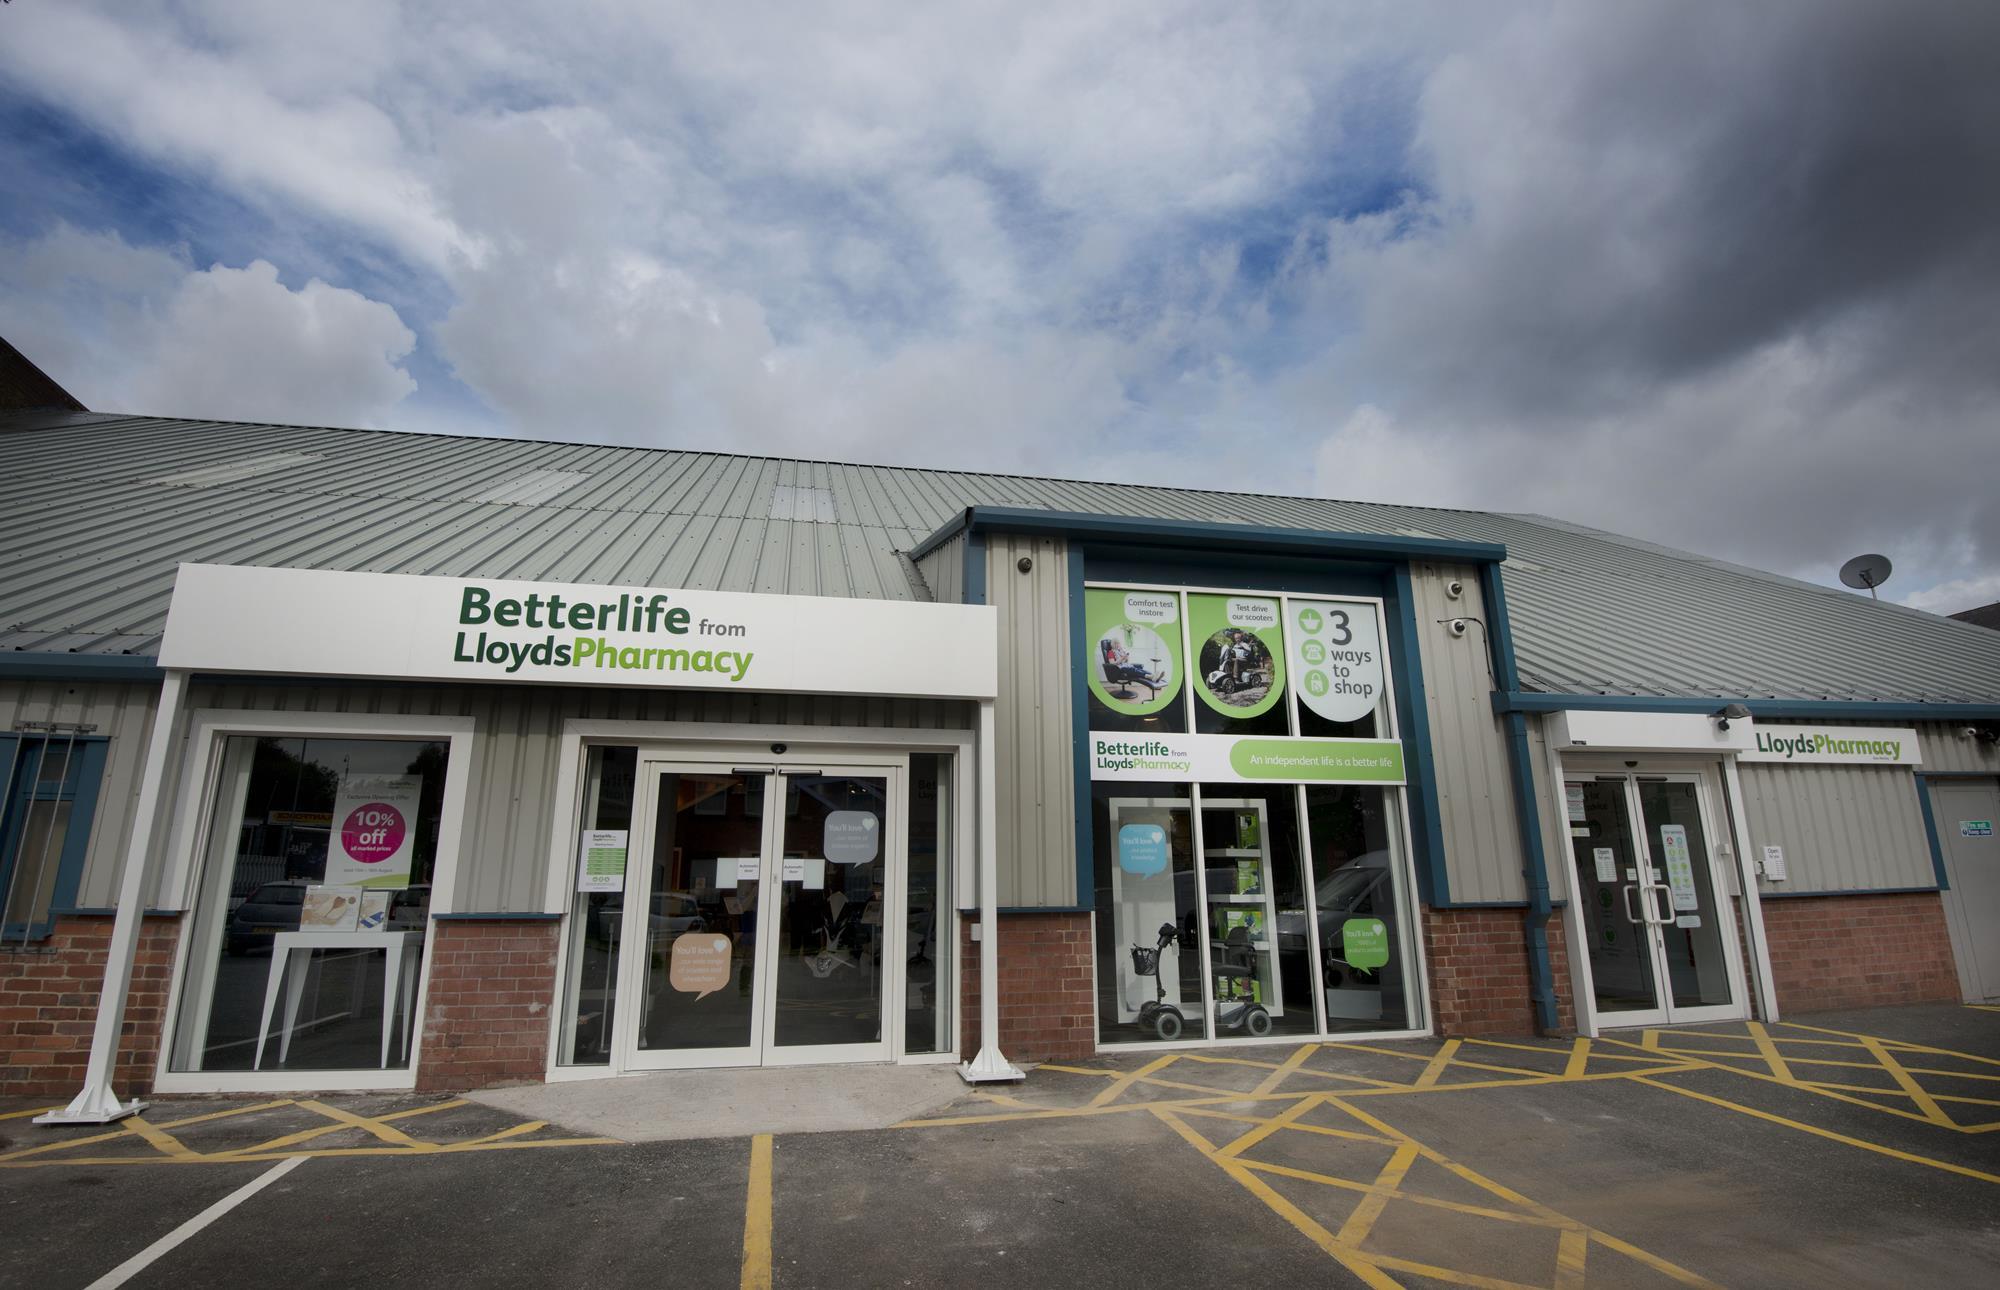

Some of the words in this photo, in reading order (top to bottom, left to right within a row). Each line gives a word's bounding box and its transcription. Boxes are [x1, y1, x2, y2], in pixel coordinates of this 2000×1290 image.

[1128, 598, 1158, 607] Comfort
[459, 586, 691, 635] Betterlife
[699, 618, 746, 637] from
[1330, 610, 1352, 646] 3
[453, 631, 754, 682] LloydsPharmacy
[1331, 650, 1372, 666] ways
[1333, 664, 1350, 678] to
[1334, 679, 1372, 699] shop
[1096, 741, 1168, 756] Betterlife
[1756, 732, 1900, 761] LloydsPharmacy
[1097, 757, 1190, 773] LloydsPharmacy
[1250, 755, 1262, 765] An
[1265, 756, 1320, 767] independent
[1322, 756, 1334, 766] life
[1336, 757, 1342, 766] is
[1352, 757, 1378, 767] better
[1380, 757, 1392, 767] life
[356, 811, 394, 826] 10%
[360, 829, 387, 844] off
